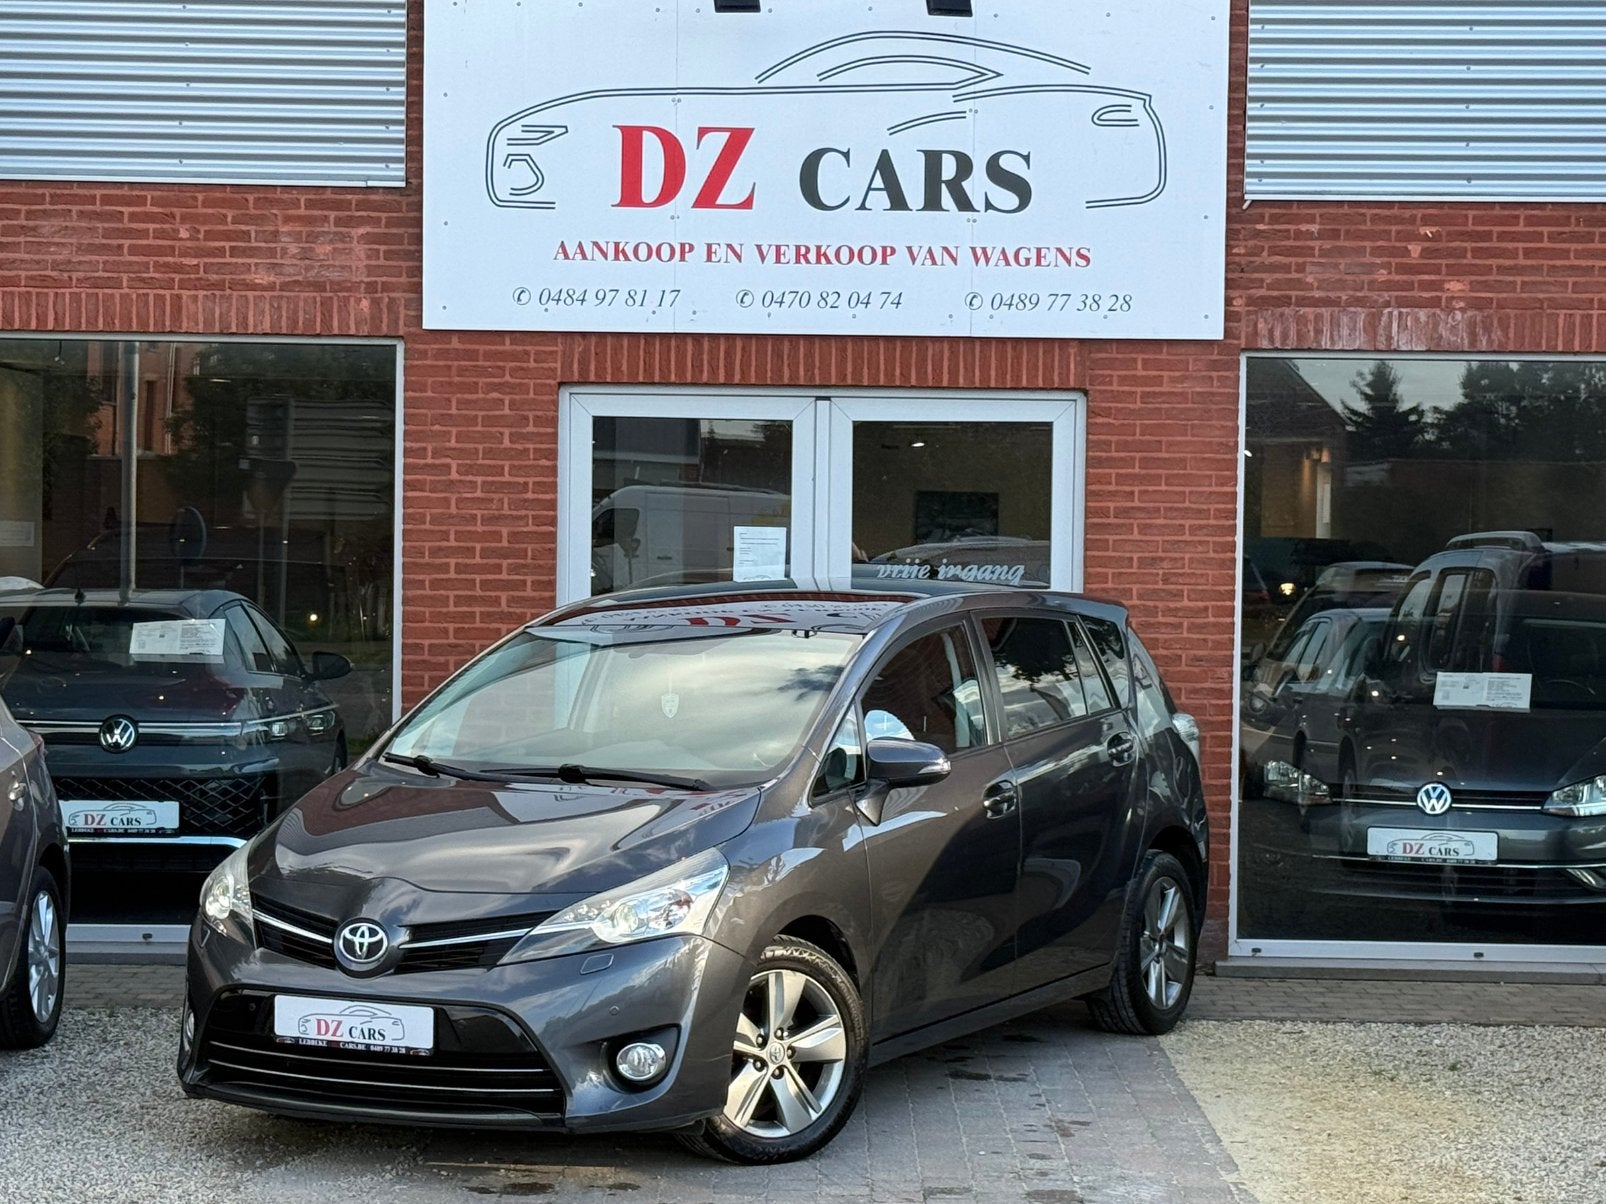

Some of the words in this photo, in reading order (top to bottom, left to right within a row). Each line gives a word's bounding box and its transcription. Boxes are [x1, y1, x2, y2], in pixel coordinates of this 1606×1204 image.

[610, 124, 756, 210] DZ
[799, 147, 1033, 214] CARS
[553, 240, 695, 263] AANKOOP
[704, 243, 744, 263] EN
[754, 243, 897, 266] VERKOOP
[905, 245, 960, 267] VAN
[969, 246, 1091, 268] WAGENS
[538, 288, 588, 307] 0484
[594, 288, 619, 307] 97
[624, 289, 648, 308] 81
[656, 289, 681, 308] 17
[761, 290, 811, 309] 0470
[817, 290, 841, 309] 82
[848, 291, 872, 310] 04
[879, 291, 904, 310] 74
[990, 292, 1040, 312] 0489
[1046, 293, 1072, 312] 77
[1076, 293, 1102, 313] 38
[1107, 293, 1133, 313] 28
[83, 813, 107, 826] DZ
[110, 817, 142, 827] CARS
[1402, 842, 1425, 856] DZ
[1428, 846, 1460, 857] CARS
[315, 1018, 344, 1038] DZ
[348, 1025, 386, 1042] CARS
